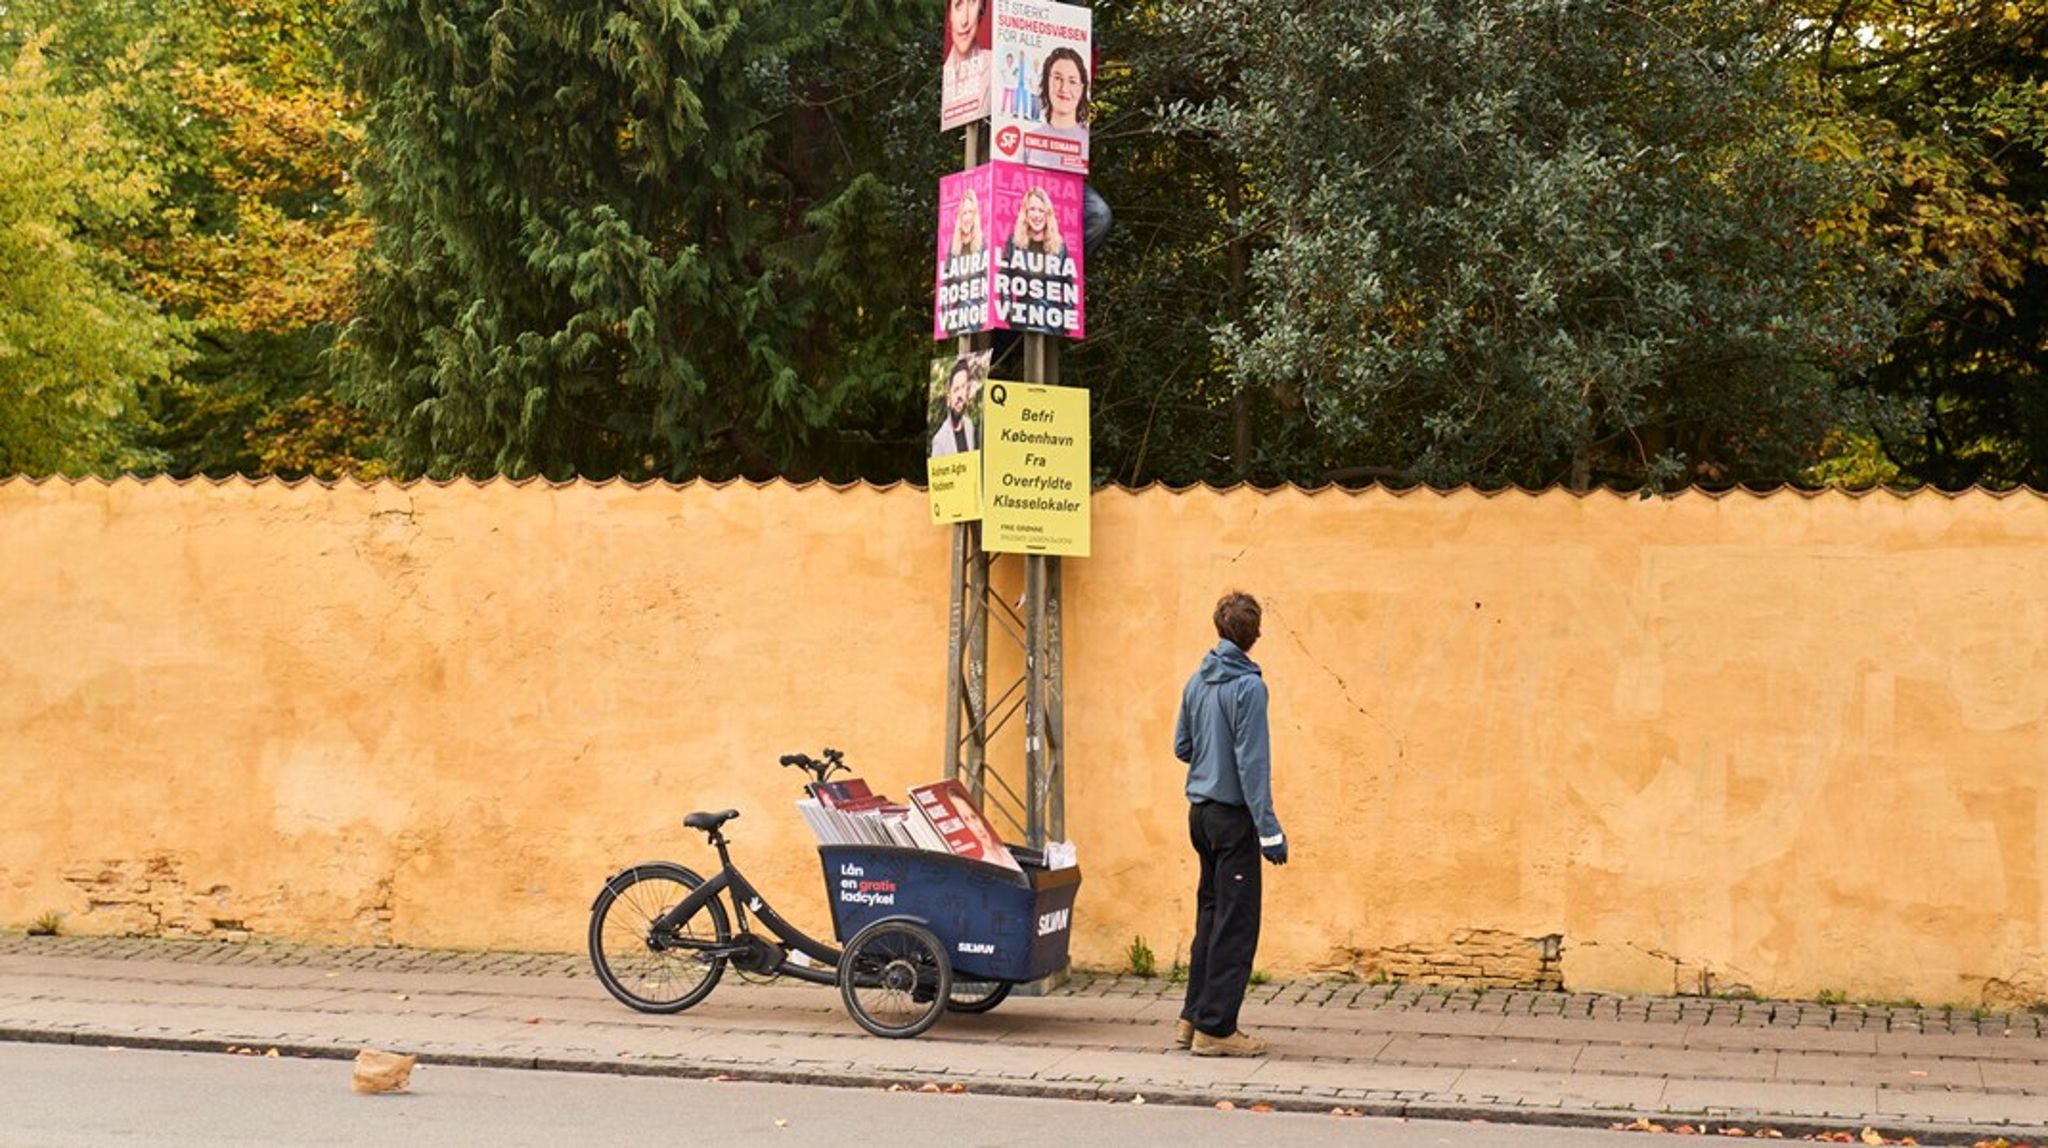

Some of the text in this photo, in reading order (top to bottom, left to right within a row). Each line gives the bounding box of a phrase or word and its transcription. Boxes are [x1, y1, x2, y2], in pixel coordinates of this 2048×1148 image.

[1012, 3, 1050, 19] STÆRKT
[998, 15, 1088, 43] SUNDHEDSVÆSEN
[998, 29, 1042, 48] FOR ALLE
[1000, 132, 1018, 148] SF
[996, 164, 1077, 199] LAURA
[940, 249, 989, 281] LAURA
[994, 247, 1077, 278] LAURA
[995, 273, 1079, 304] ROSEN
[994, 300, 1080, 330] VINGE
[990, 384, 1007, 406] Q
[1021, 408, 1054, 423] Befri
[1000, 428, 1073, 446] København
[1025, 453, 1046, 467] Fra
[1002, 473, 1072, 491] Overfyldte
[993, 494, 1080, 512] Klasselokaler
[841, 862, 864, 877] Lån
[841, 879, 897, 893] en gratis
[841, 890, 895, 907] ladcykel
[1037, 907, 1069, 937] SILVAN
[958, 942, 995, 955] SILVAN
